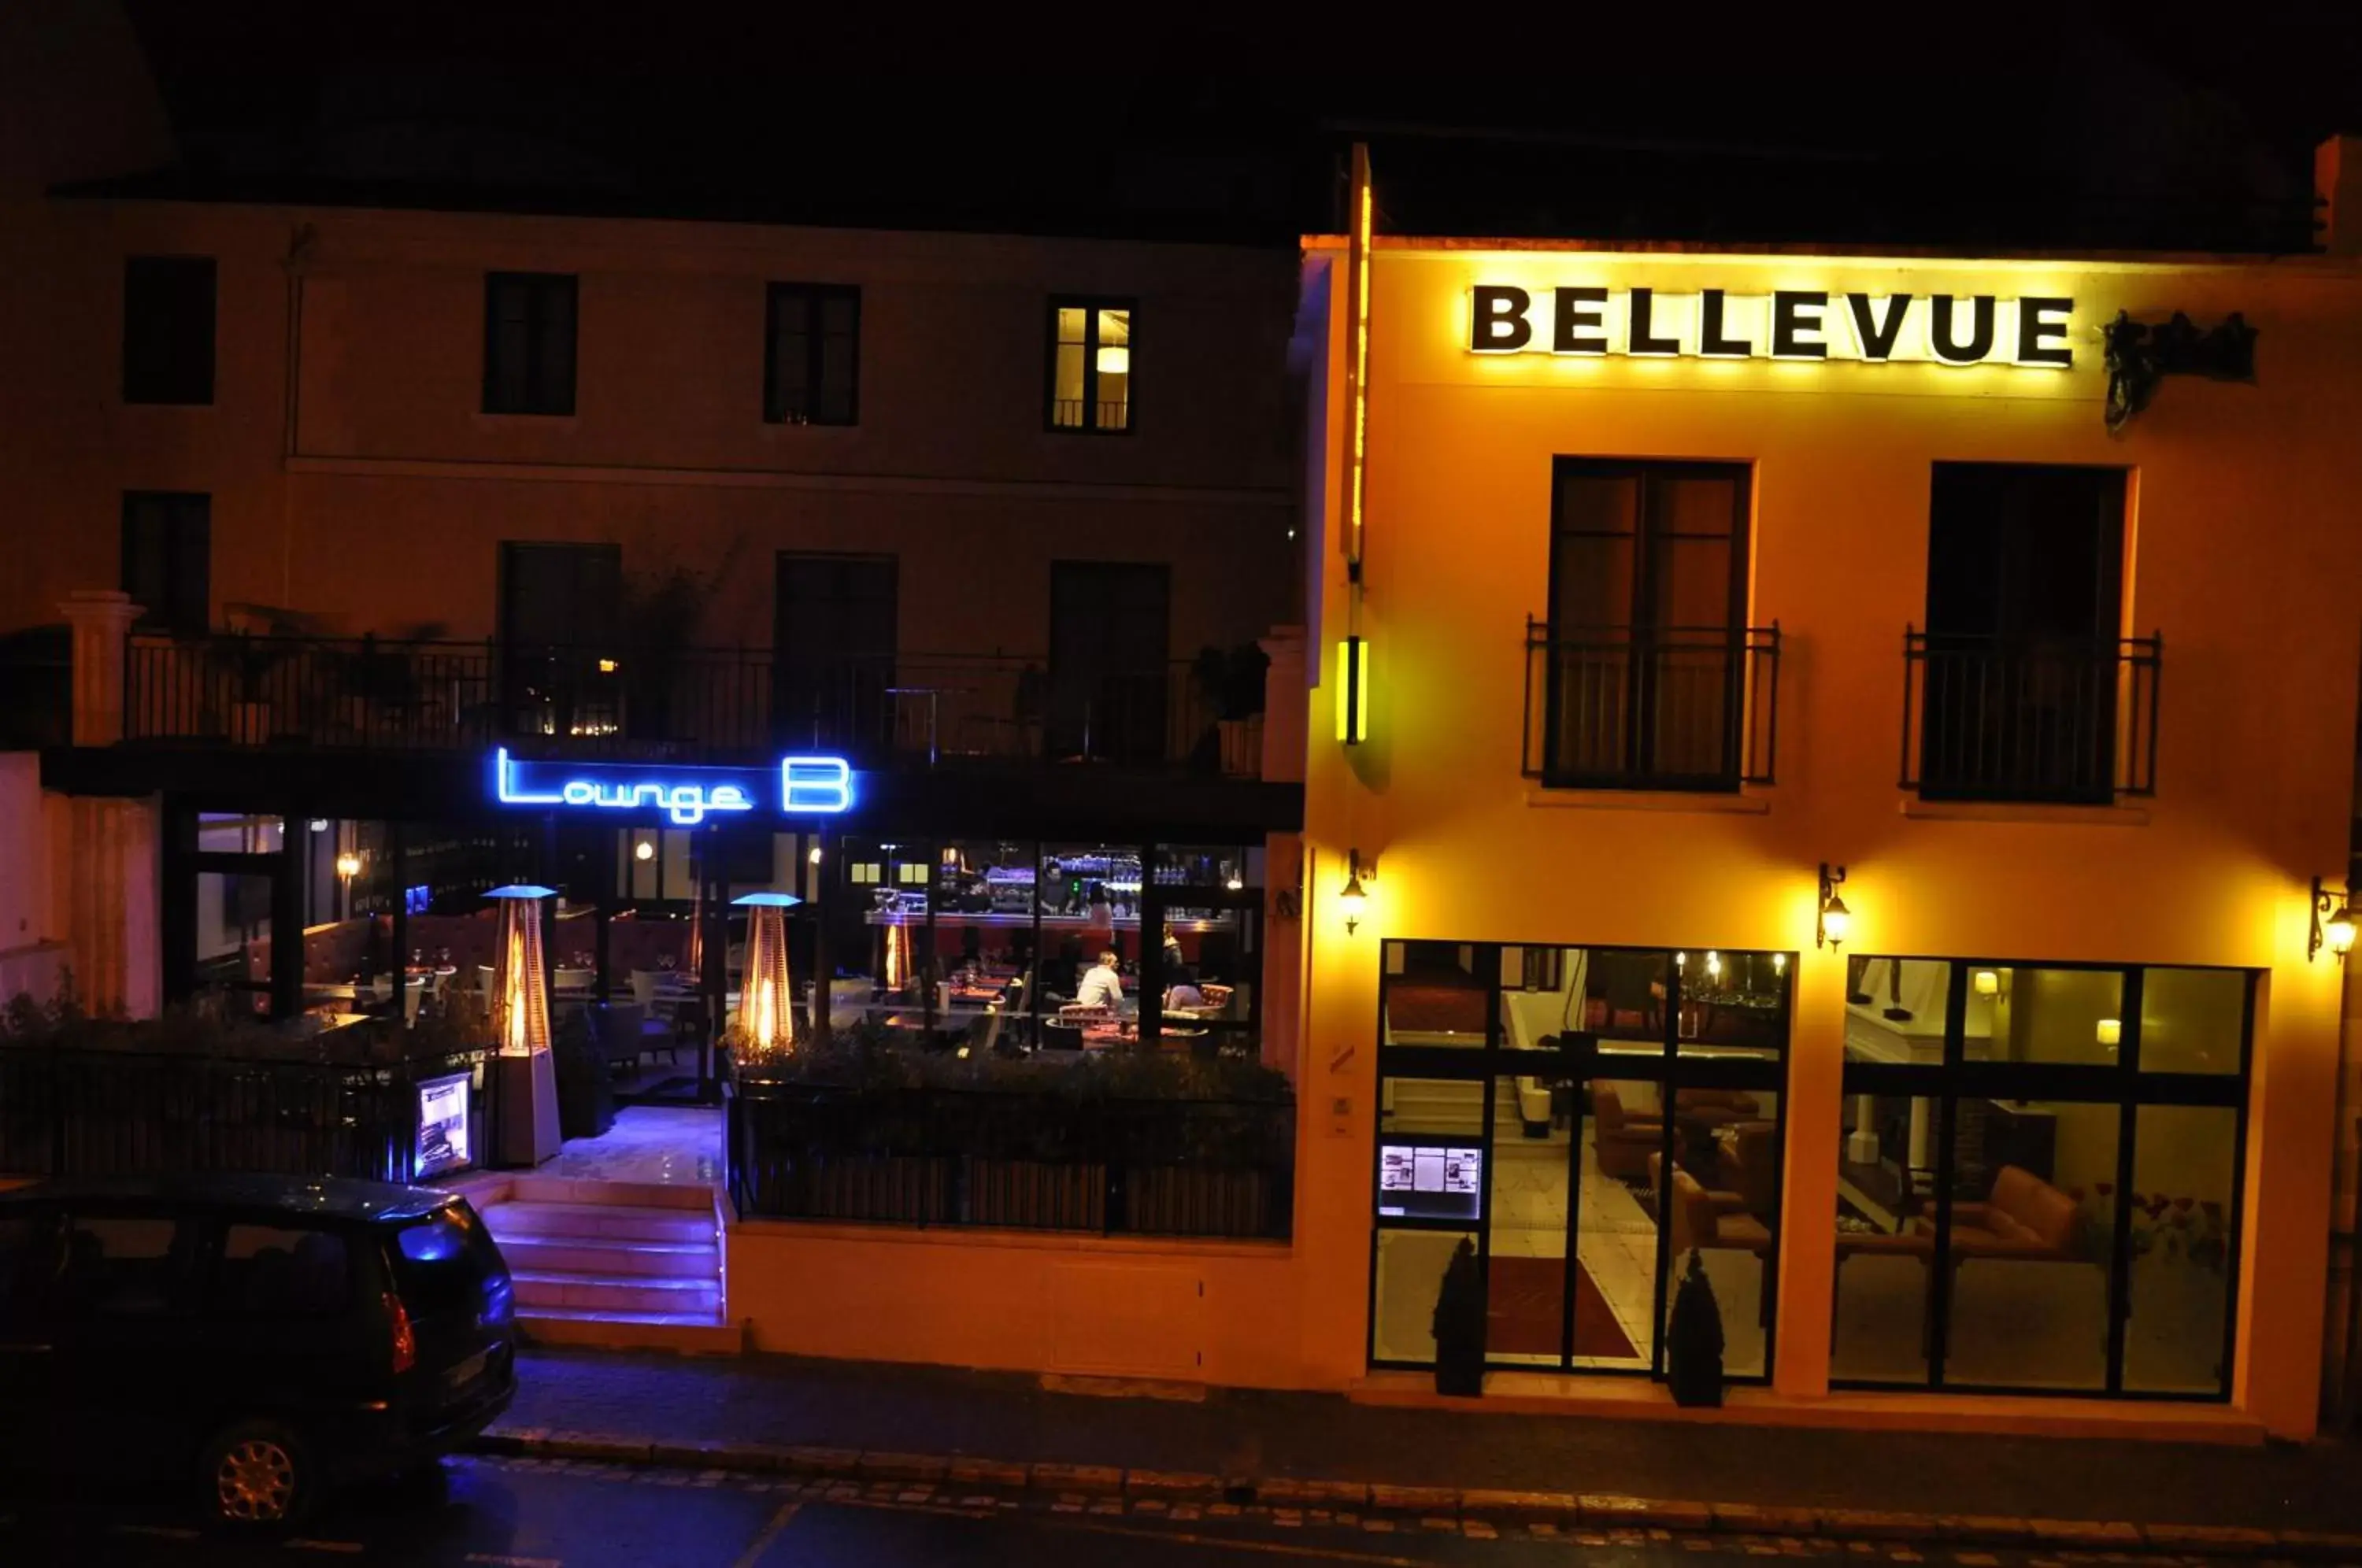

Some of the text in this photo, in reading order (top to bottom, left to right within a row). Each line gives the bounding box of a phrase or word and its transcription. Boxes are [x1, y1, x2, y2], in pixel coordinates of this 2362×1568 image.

[1470, 284, 2075, 367] BELLEVUE
[498, 746, 850, 825] Lounge B
